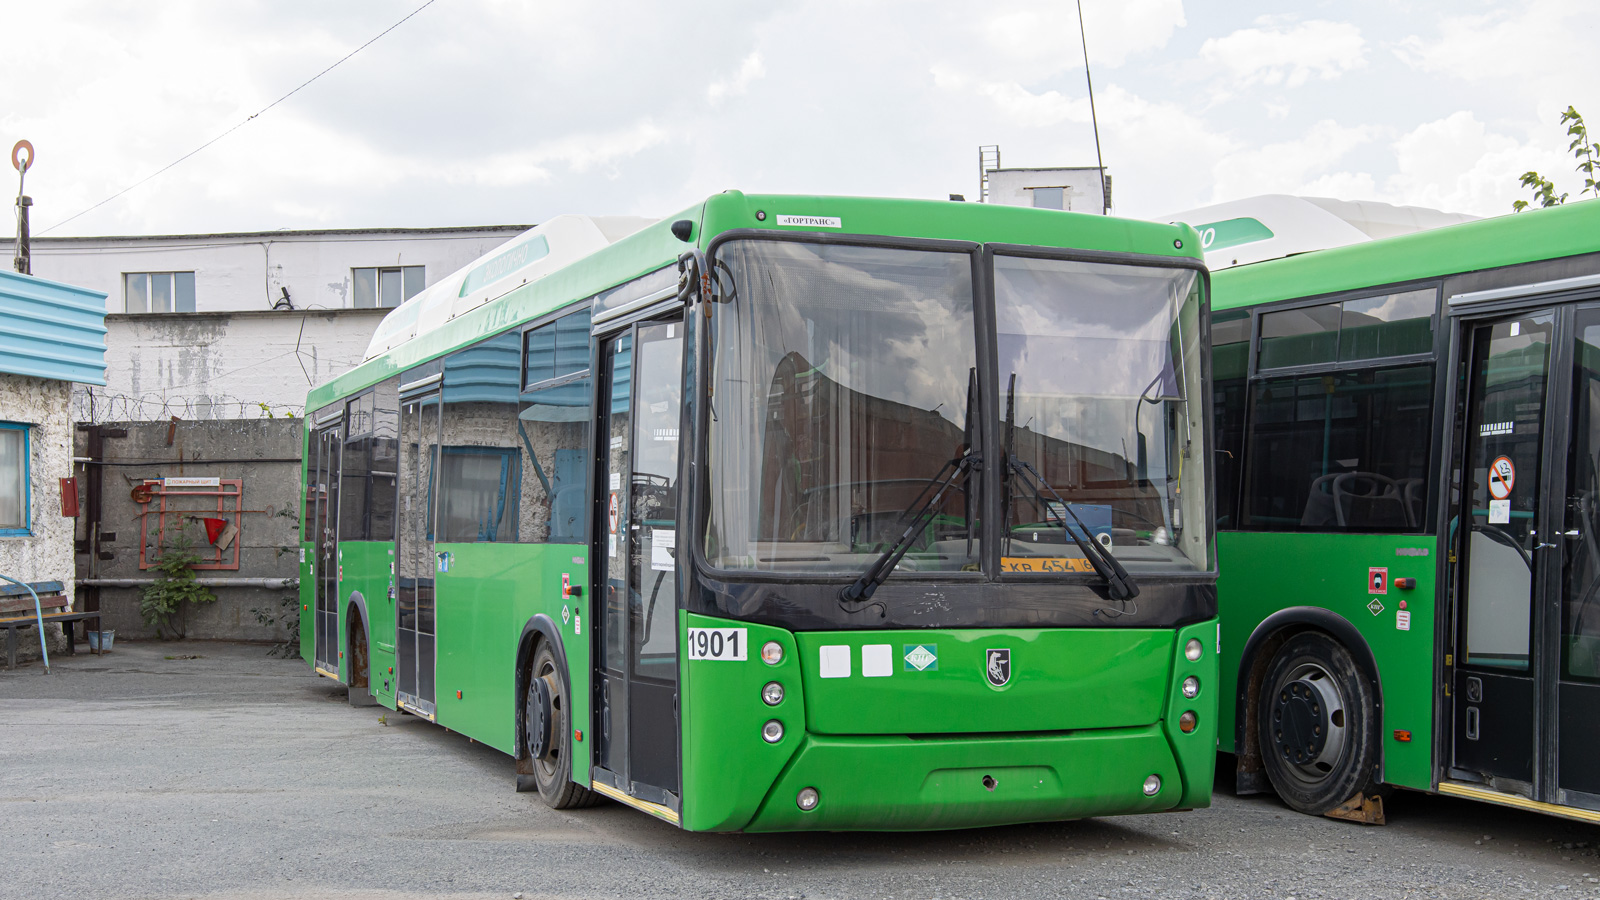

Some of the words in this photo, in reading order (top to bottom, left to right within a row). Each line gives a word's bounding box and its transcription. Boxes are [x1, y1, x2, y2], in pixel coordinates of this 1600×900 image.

[783, 217, 835, 226] «ГОРТРАНС»
[1041, 560, 1076, 573] 454
[689, 630, 739, 657] 1901
